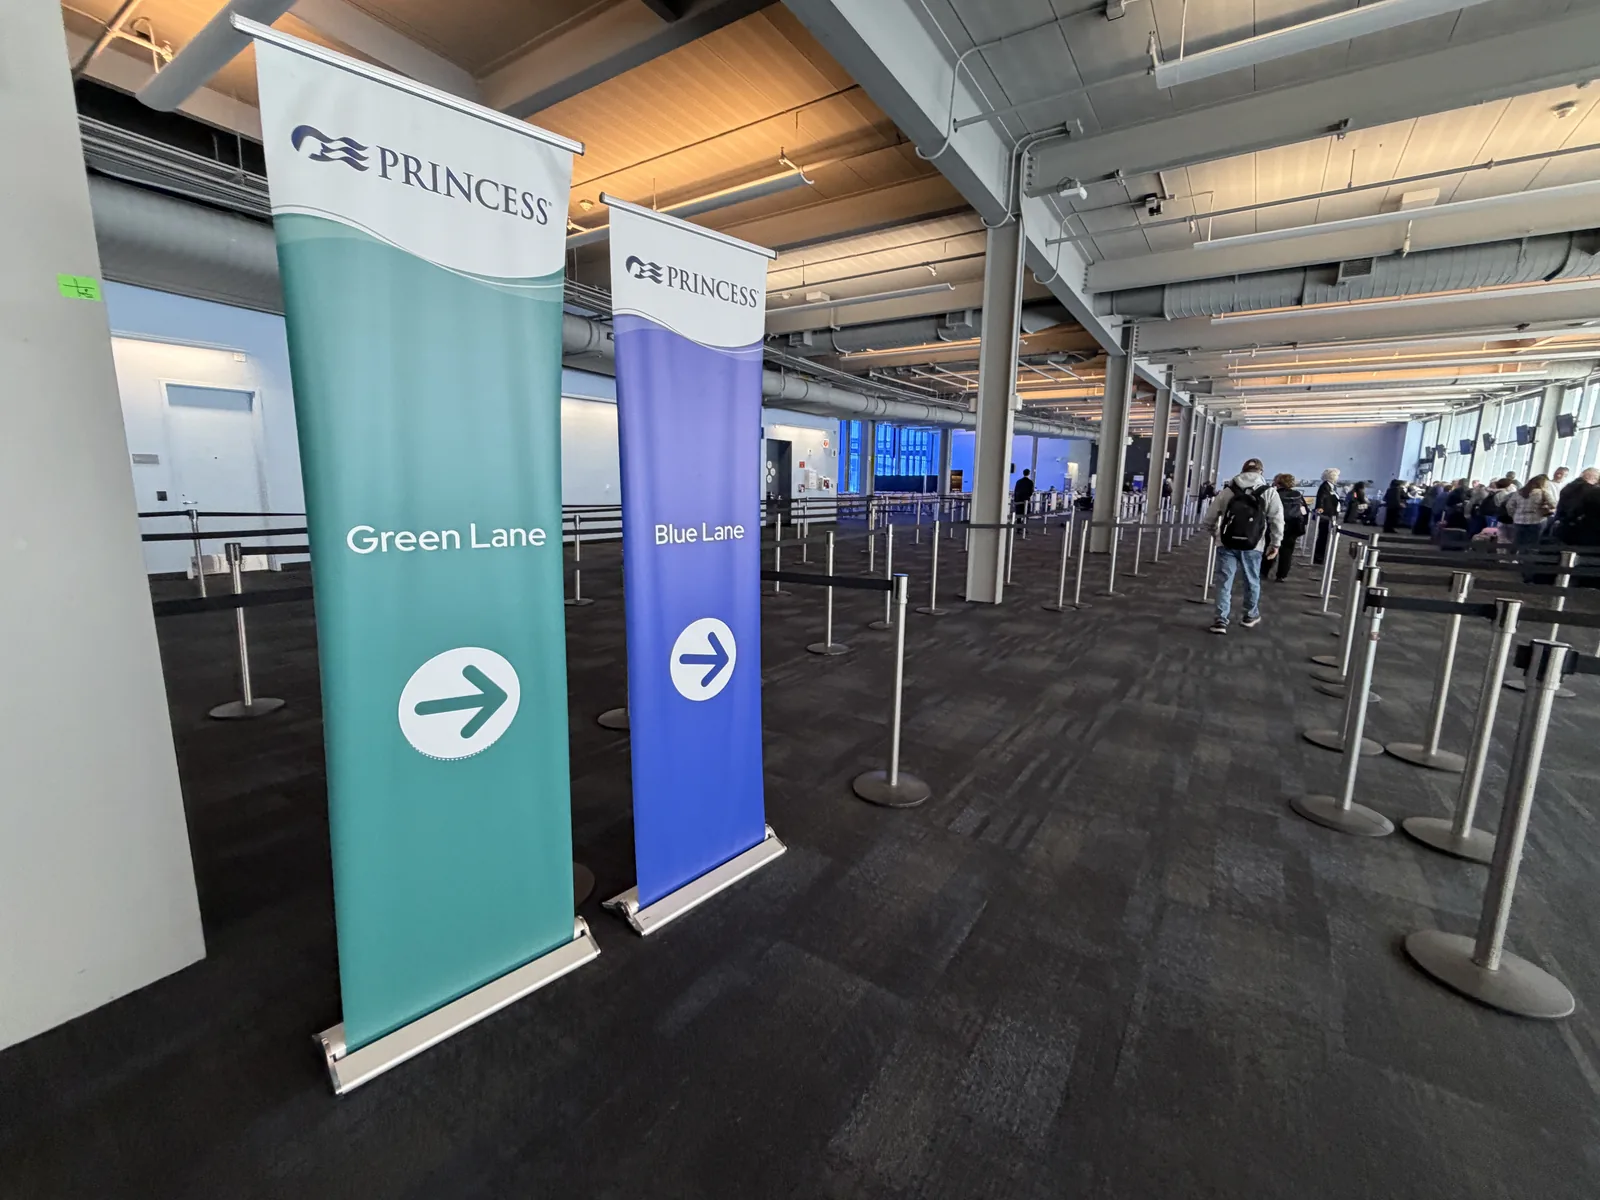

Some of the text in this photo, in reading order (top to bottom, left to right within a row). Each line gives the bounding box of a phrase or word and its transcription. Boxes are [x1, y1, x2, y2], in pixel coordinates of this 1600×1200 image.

[376, 145, 549, 225] PRINCESS
[667, 265, 758, 308] PRINCESS
[346, 523, 546, 554] Green Lane
[655, 522, 745, 545] Blue Lane
